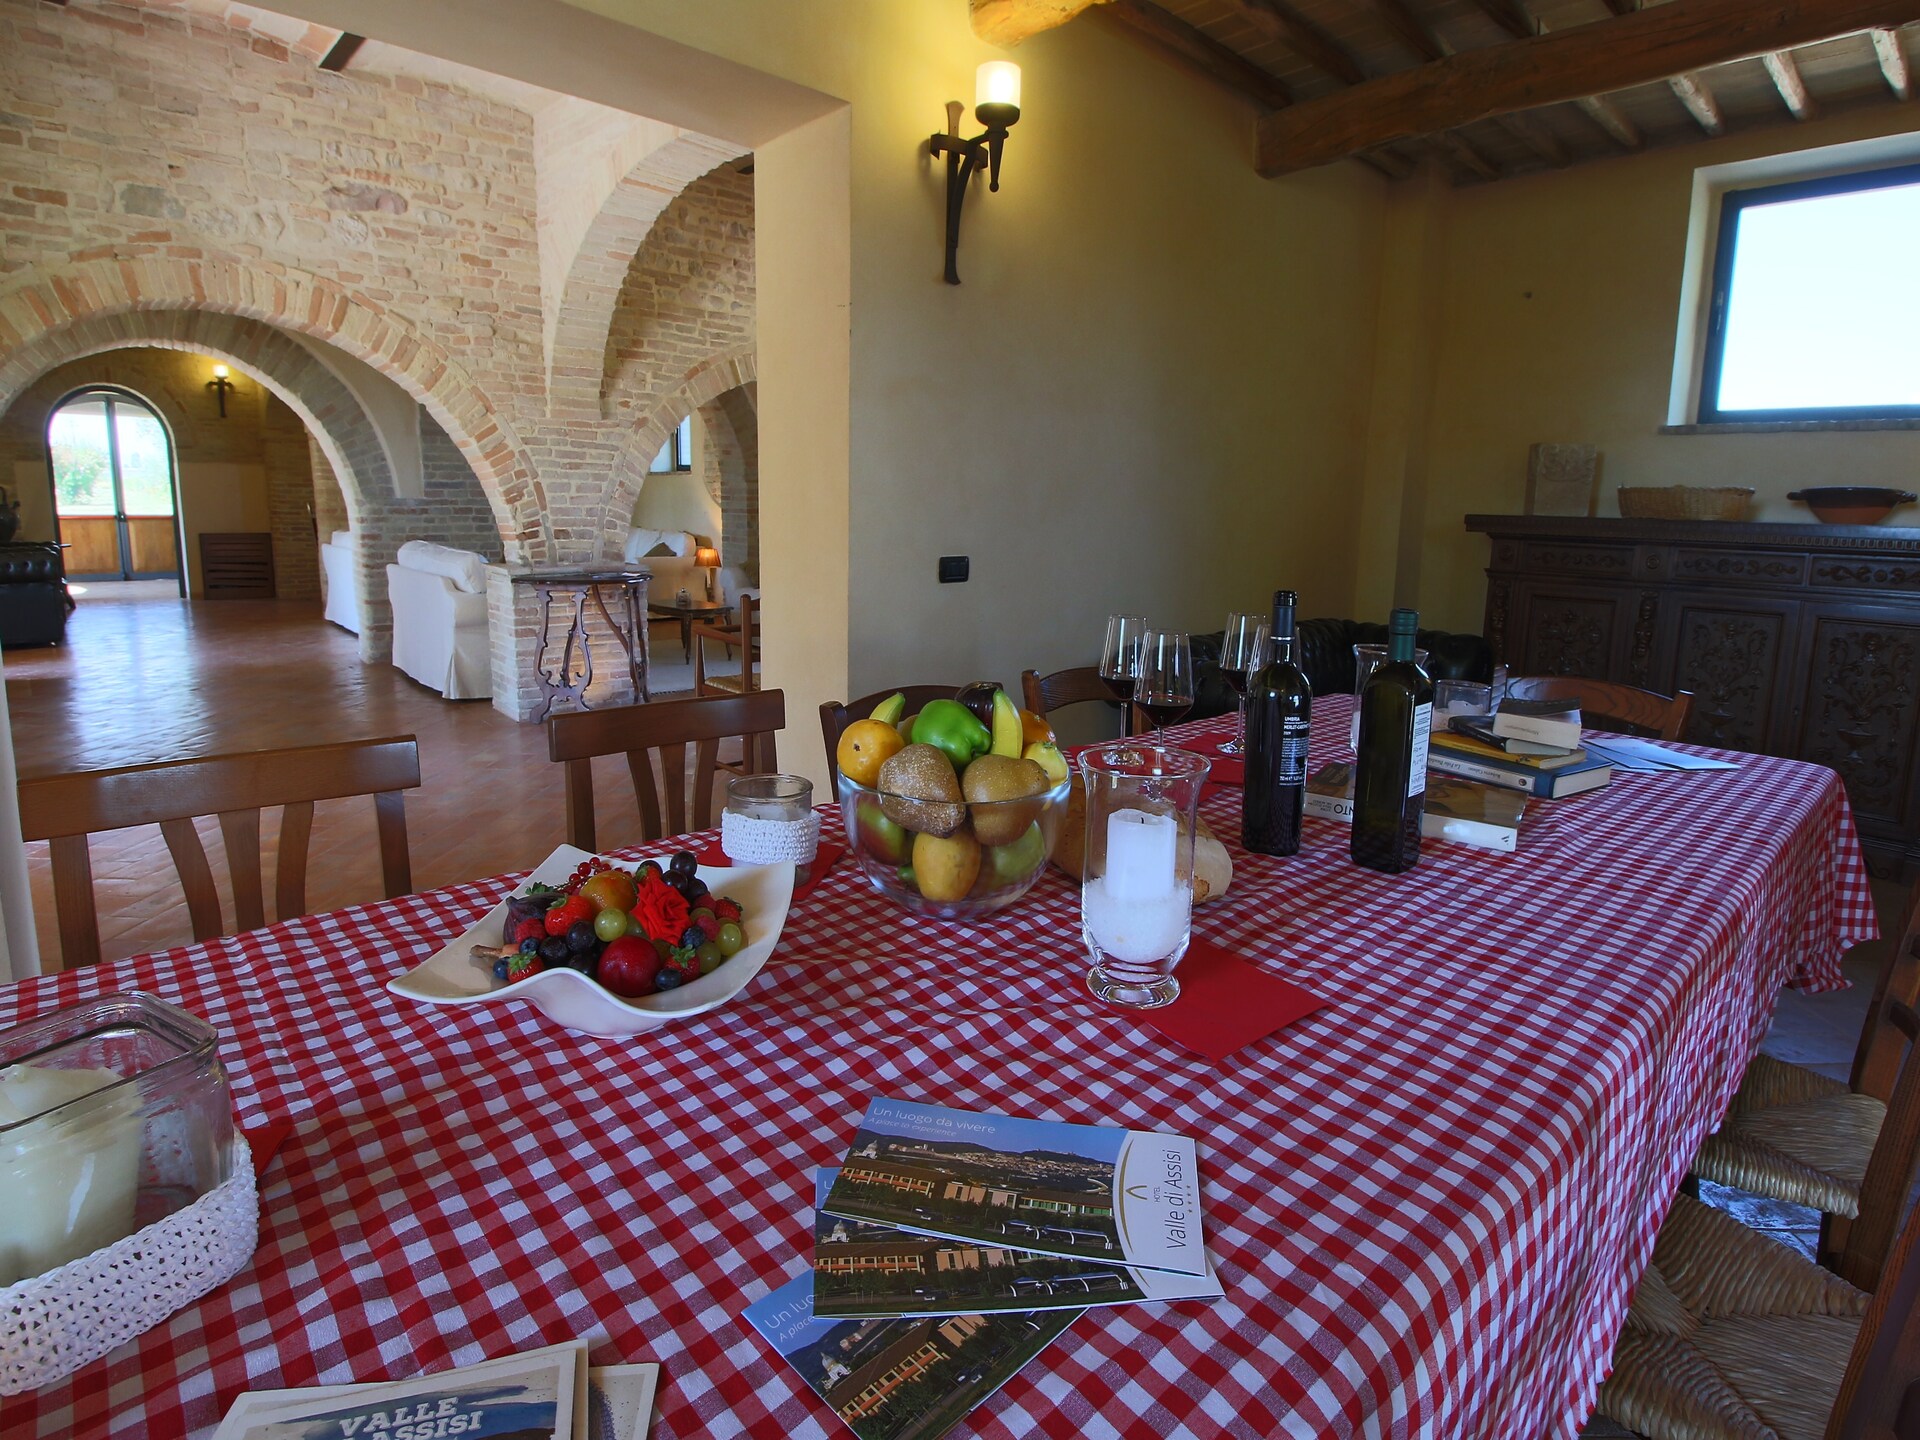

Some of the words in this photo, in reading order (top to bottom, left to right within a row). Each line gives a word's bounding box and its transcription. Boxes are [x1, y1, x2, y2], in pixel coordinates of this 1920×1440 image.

[1333, 804, 1353, 816] NTO
[873, 1106, 892, 1117] Un
[895, 1110, 932, 1124] luogo
[936, 1117, 952, 1127] da
[956, 1121, 996, 1134] vivere
[875, 1119, 900, 1127] place
[900, 1121, 910, 1129] to
[911, 1125, 957, 1137] experience
[1162, 1149, 1182, 1190] Assisi
[1163, 1191, 1184, 1207] di
[1164, 1210, 1186, 1249] Valle
[764, 1309, 792, 1329] Un
[791, 1294, 815, 1312] luo
[779, 1332, 787, 1343] A
[788, 1315, 815, 1339] place
[339, 1396, 459, 1437] VALLE
[372, 1410, 484, 1440] ASSISI
